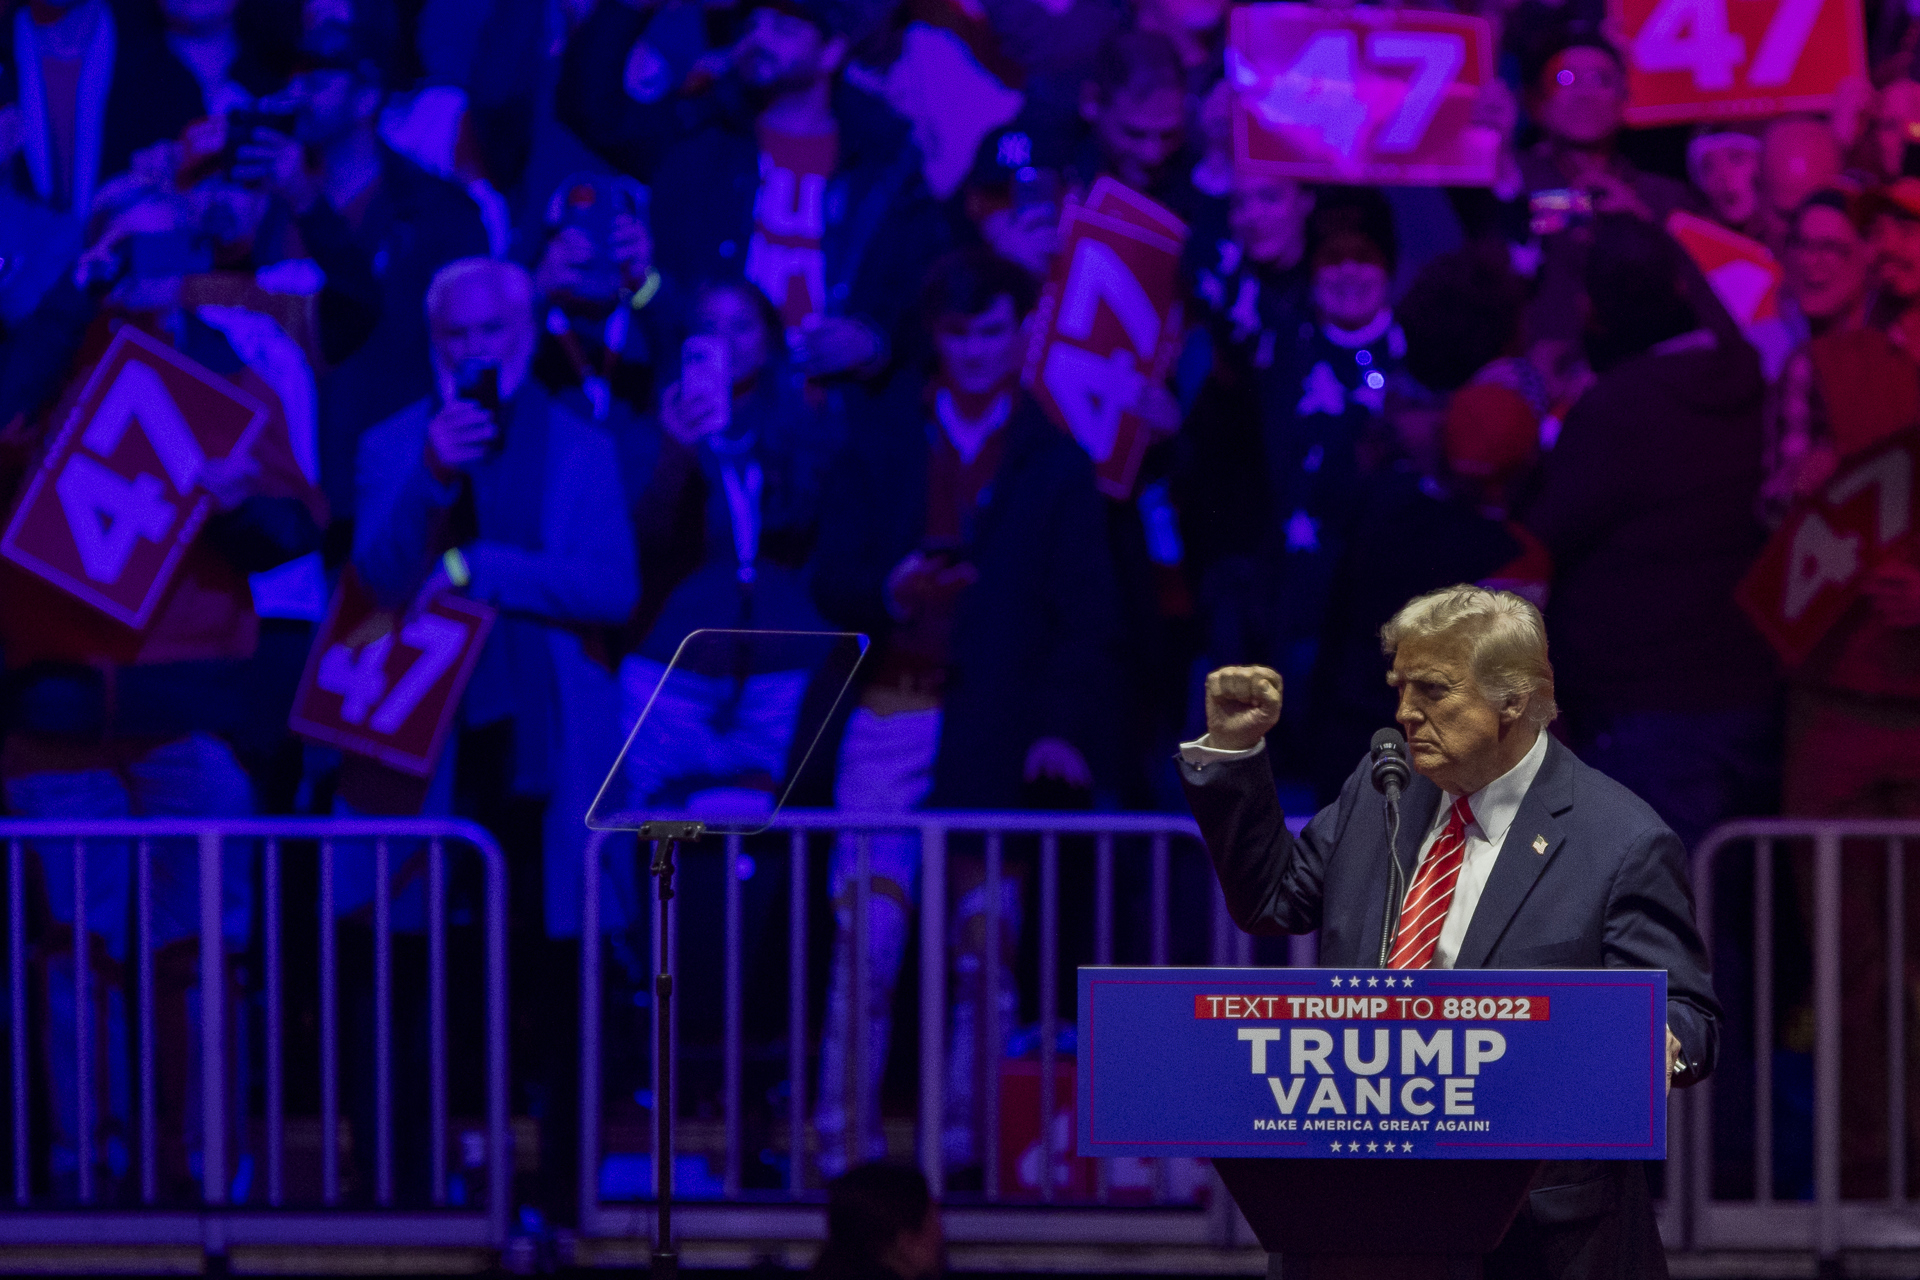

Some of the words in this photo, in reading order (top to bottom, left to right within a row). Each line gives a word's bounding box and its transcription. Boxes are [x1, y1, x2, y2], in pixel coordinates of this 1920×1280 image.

[1256, 29, 1466, 155] 47
[1042, 236, 1162, 464] 47
[54, 358, 207, 585] 47
[1783, 448, 1911, 620] 47
[318, 611, 469, 735] 47
[1206, 996, 1279, 1018] TEXT
[1286, 996, 1388, 1019] TRUMP
[1395, 997, 1434, 1019] TO
[1442, 997, 1531, 1020] 88022
[1237, 1028, 1507, 1076] TRUMP
[1253, 1119, 1297, 1131] MAKE
[1302, 1119, 1374, 1132] AMERICA
[1378, 1120, 1430, 1132] GREAT
[1434, 1120, 1491, 1132] AGAIN!
[1267, 1077, 1476, 1116] VANCE
